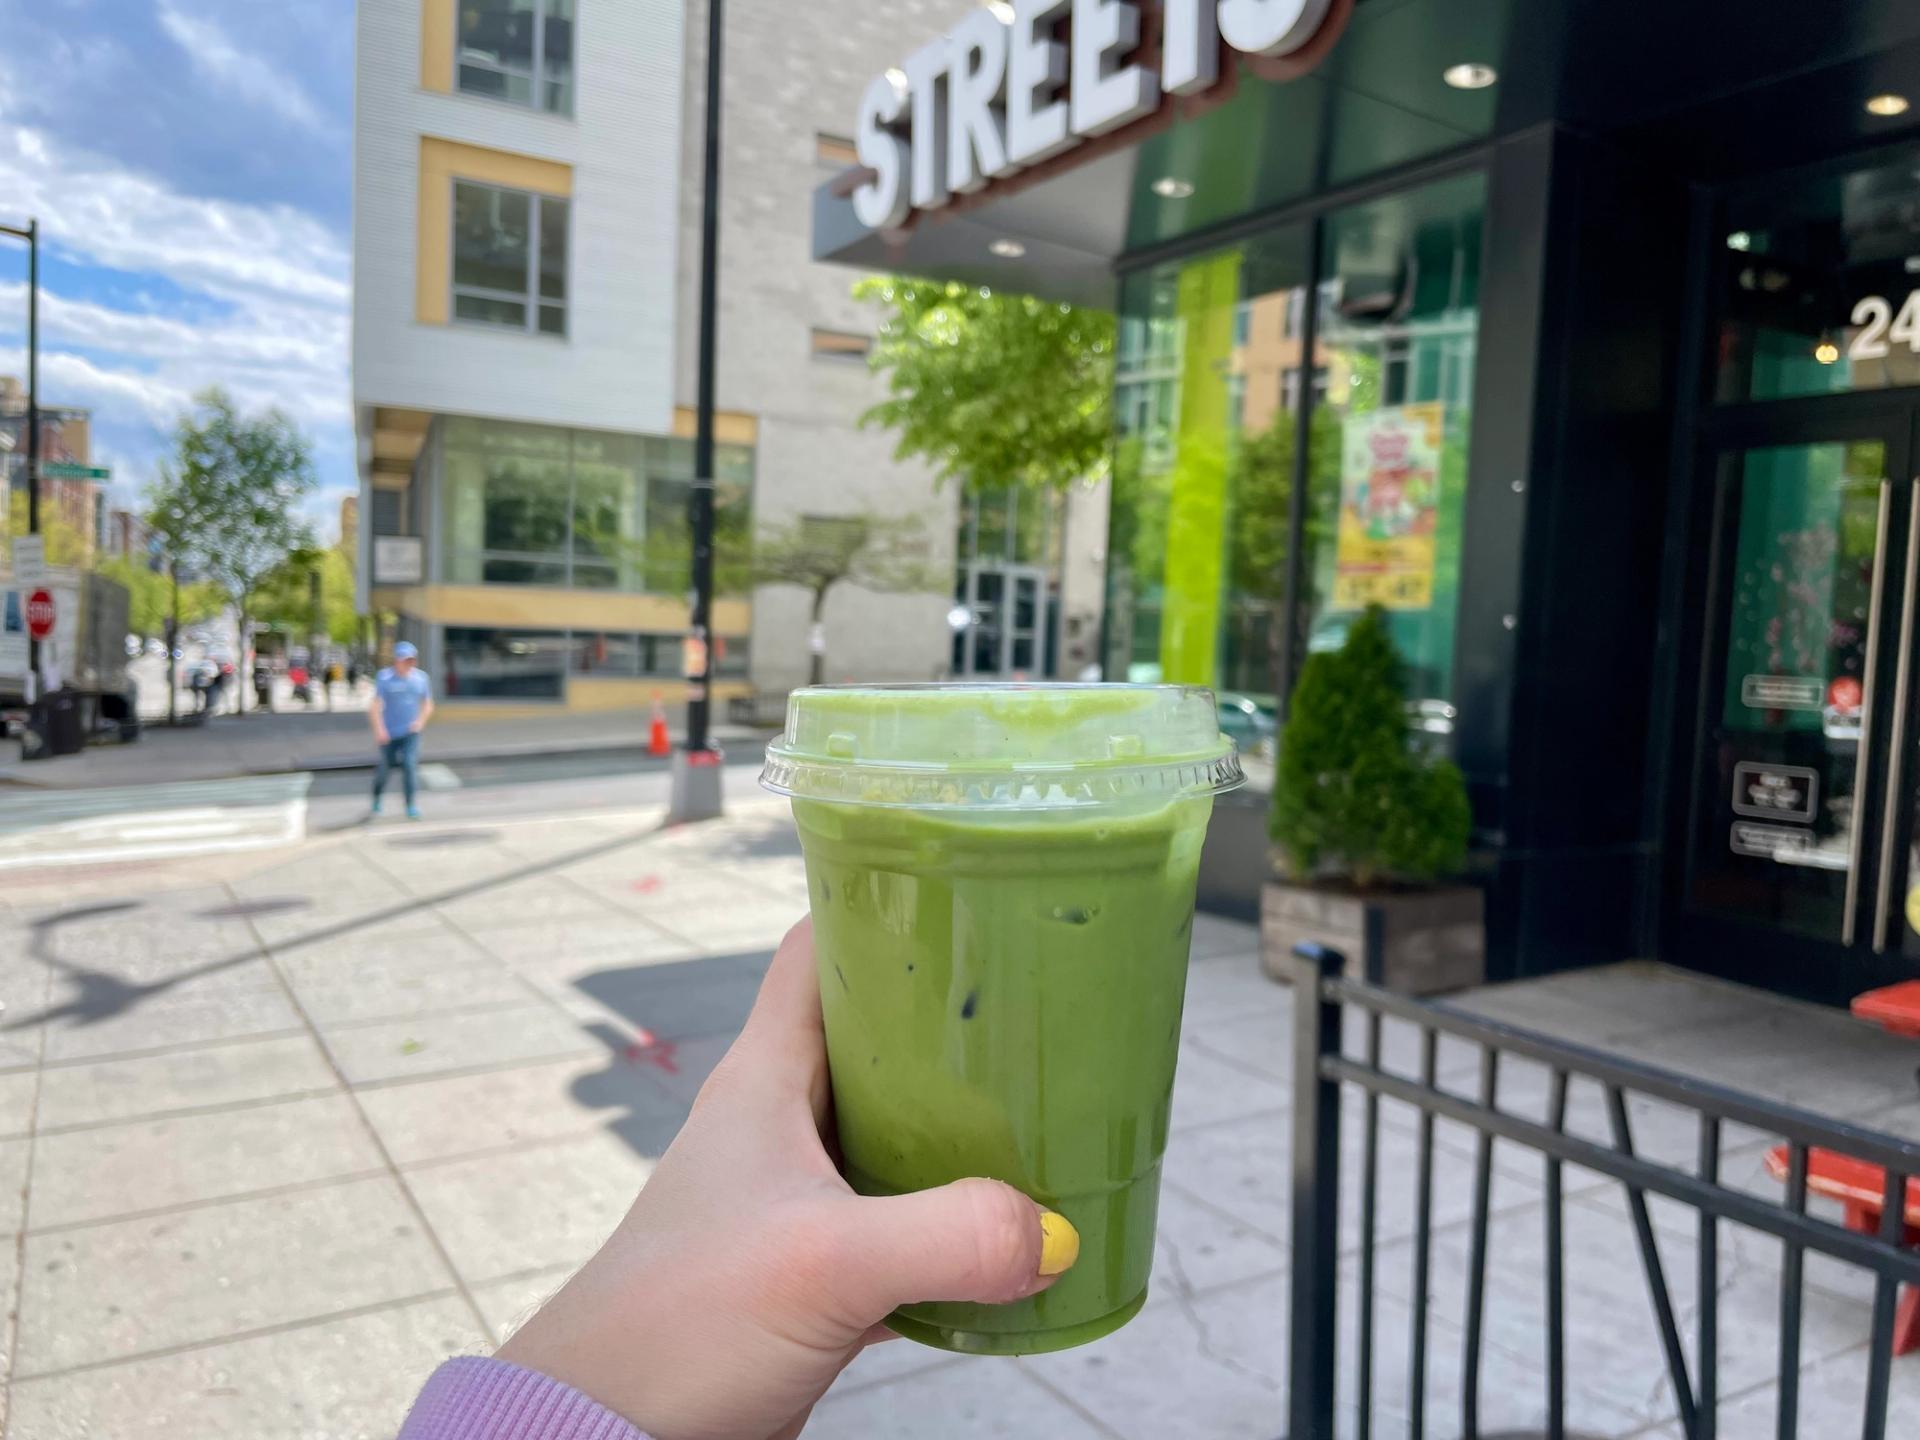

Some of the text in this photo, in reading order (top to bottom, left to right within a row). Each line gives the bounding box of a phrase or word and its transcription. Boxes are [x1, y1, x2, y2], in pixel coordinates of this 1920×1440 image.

[852, 0, 1330, 229] STREE
[1848, 288, 1920, 361] 24
[27, 602, 55, 620] STOP
